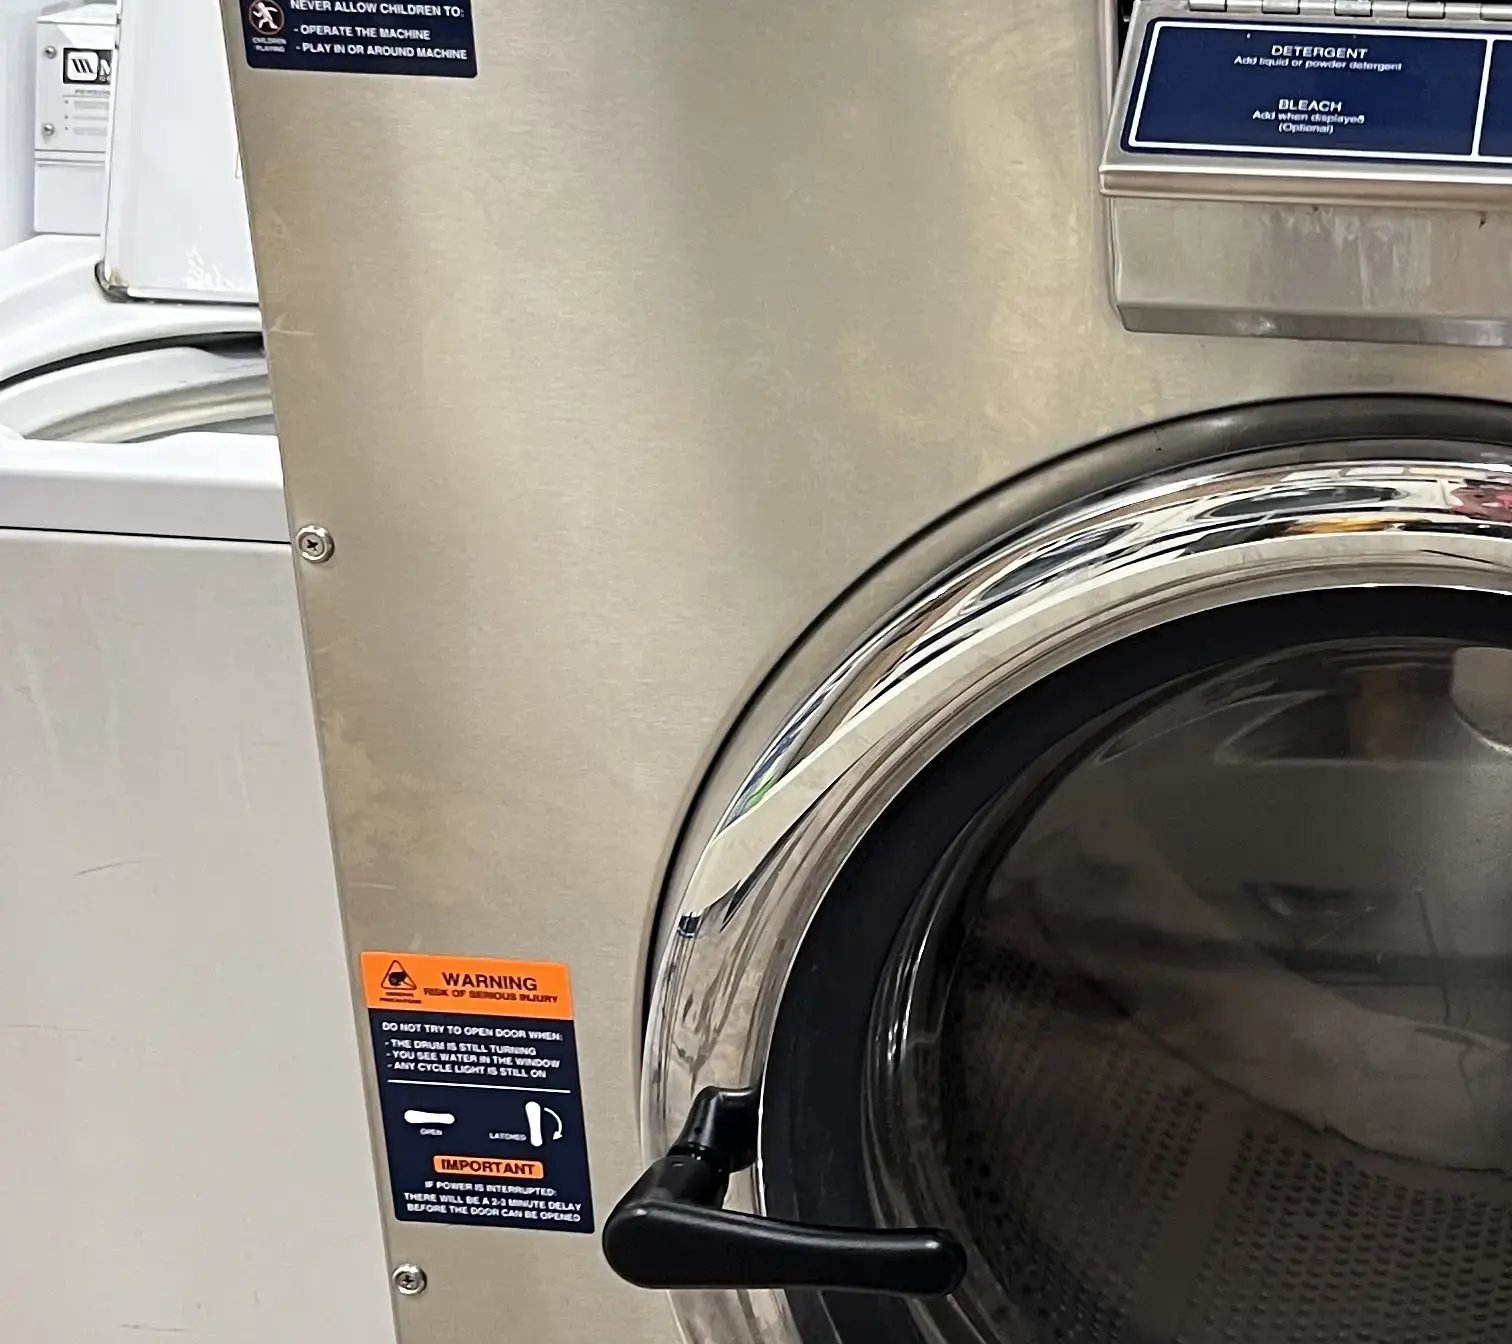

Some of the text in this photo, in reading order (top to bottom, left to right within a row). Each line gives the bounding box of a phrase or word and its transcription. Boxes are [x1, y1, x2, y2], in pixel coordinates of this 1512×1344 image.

[290, 0, 464, 18] NEVER ALLOW CHILDREN TO:
[300, 25, 430, 40] OPERATE THE MACHINE
[302, 43, 468, 60] PLAY IN OR AROUND MACHINE
[1271, 44, 1368, 58] DETERGENT
[1234, 56, 1257, 66] Add
[1260, 57, 1289, 68] liquid
[1305, 59, 1346, 70] powder
[1350, 61, 1402, 72] detergent
[1278, 98, 1342, 112] BLEACH
[1252, 110, 1364, 125] Add when displayed
[1278, 122, 1334, 134] (Optional)
[441, 972, 538, 991] WARNING
[452, 989, 466, 998] OF
[441, 1158, 535, 1175] IMPORTANT
